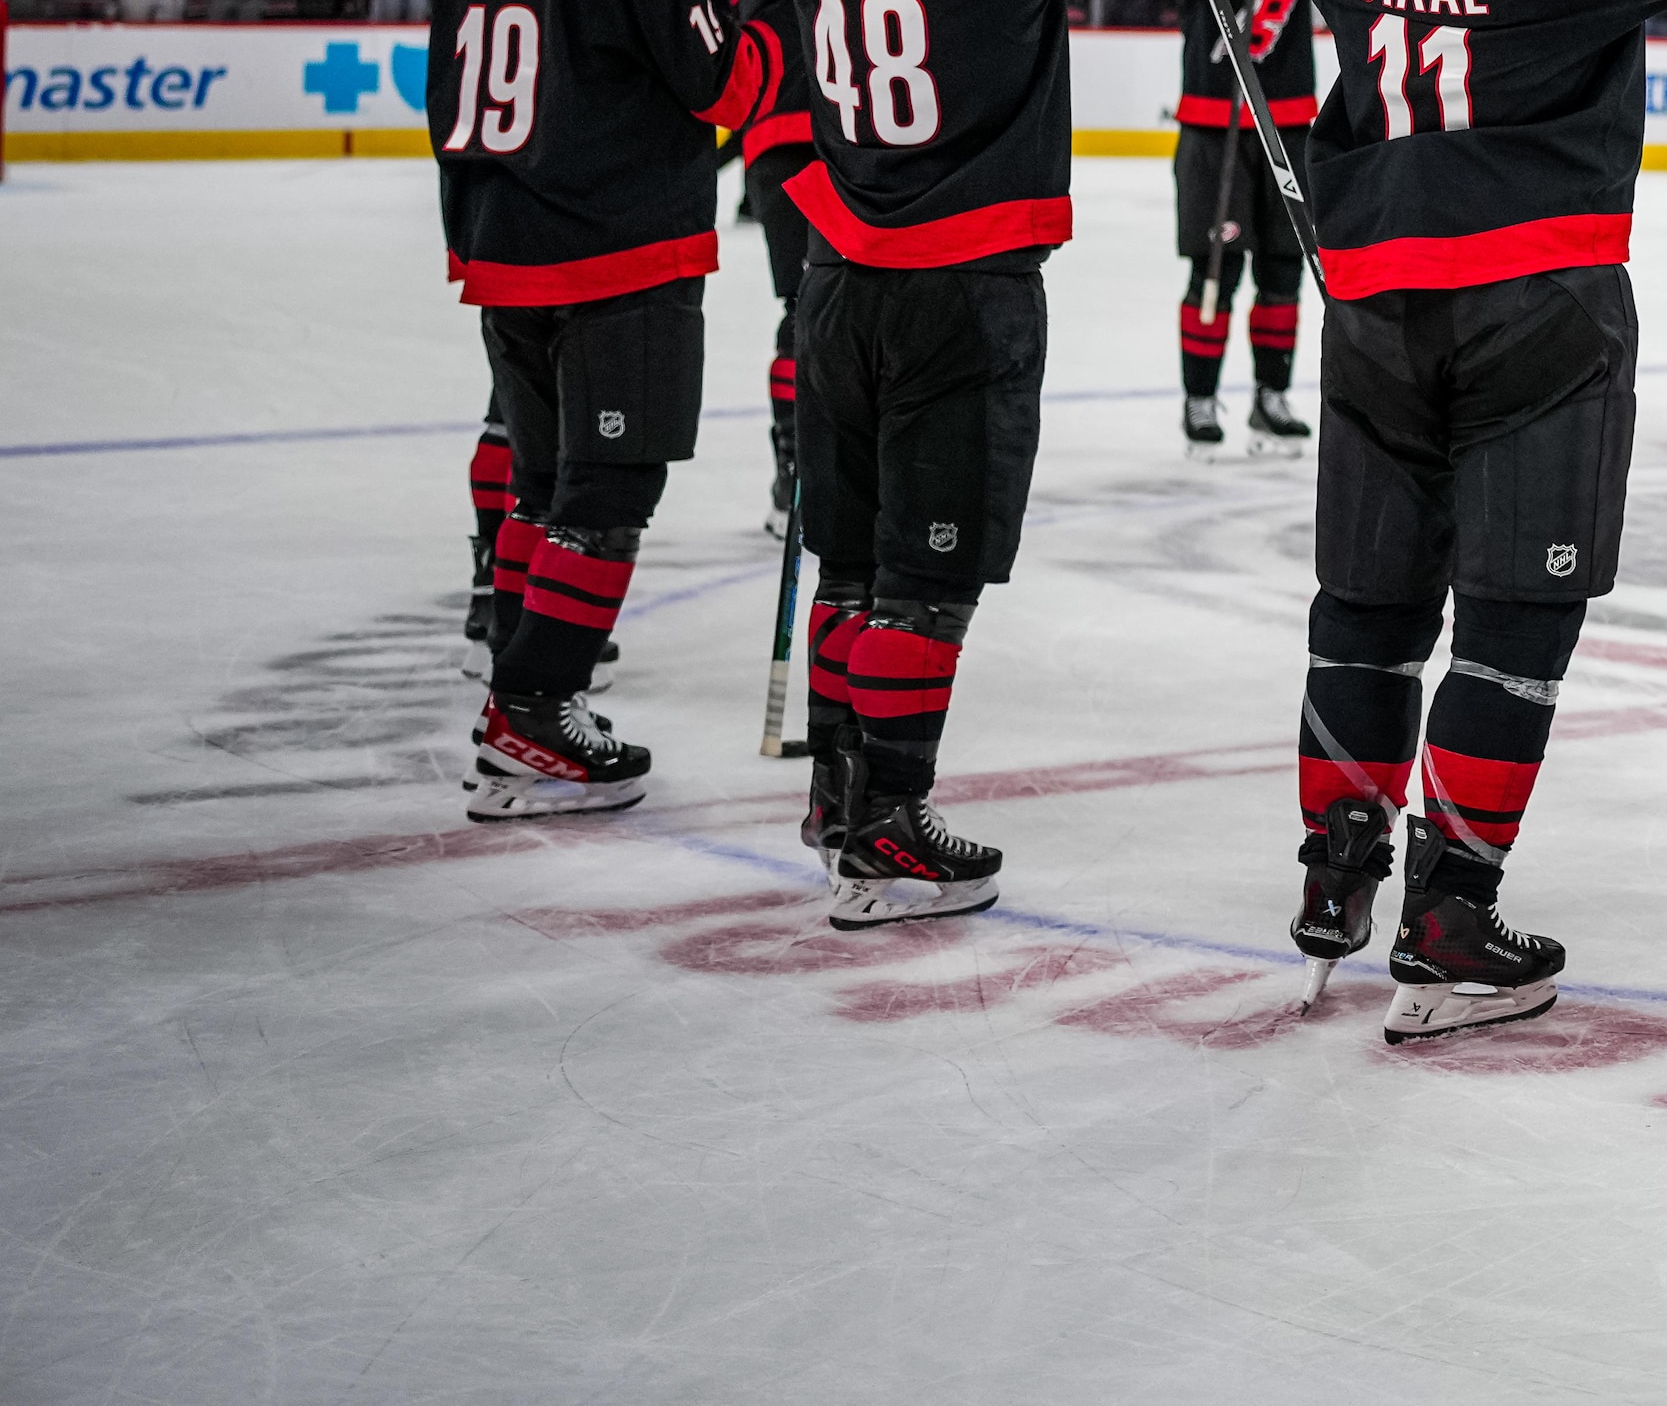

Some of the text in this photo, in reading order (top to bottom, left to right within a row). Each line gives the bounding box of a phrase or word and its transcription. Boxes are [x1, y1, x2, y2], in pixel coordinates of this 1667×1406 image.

[442, 3, 538, 152] 19
[1367, 14, 1472, 141] 11
[1552, 550, 1573, 570] NHL
[494, 733, 584, 779] CCM
[875, 837, 940, 880] CCM
[1484, 942, 1523, 964] BAUER
